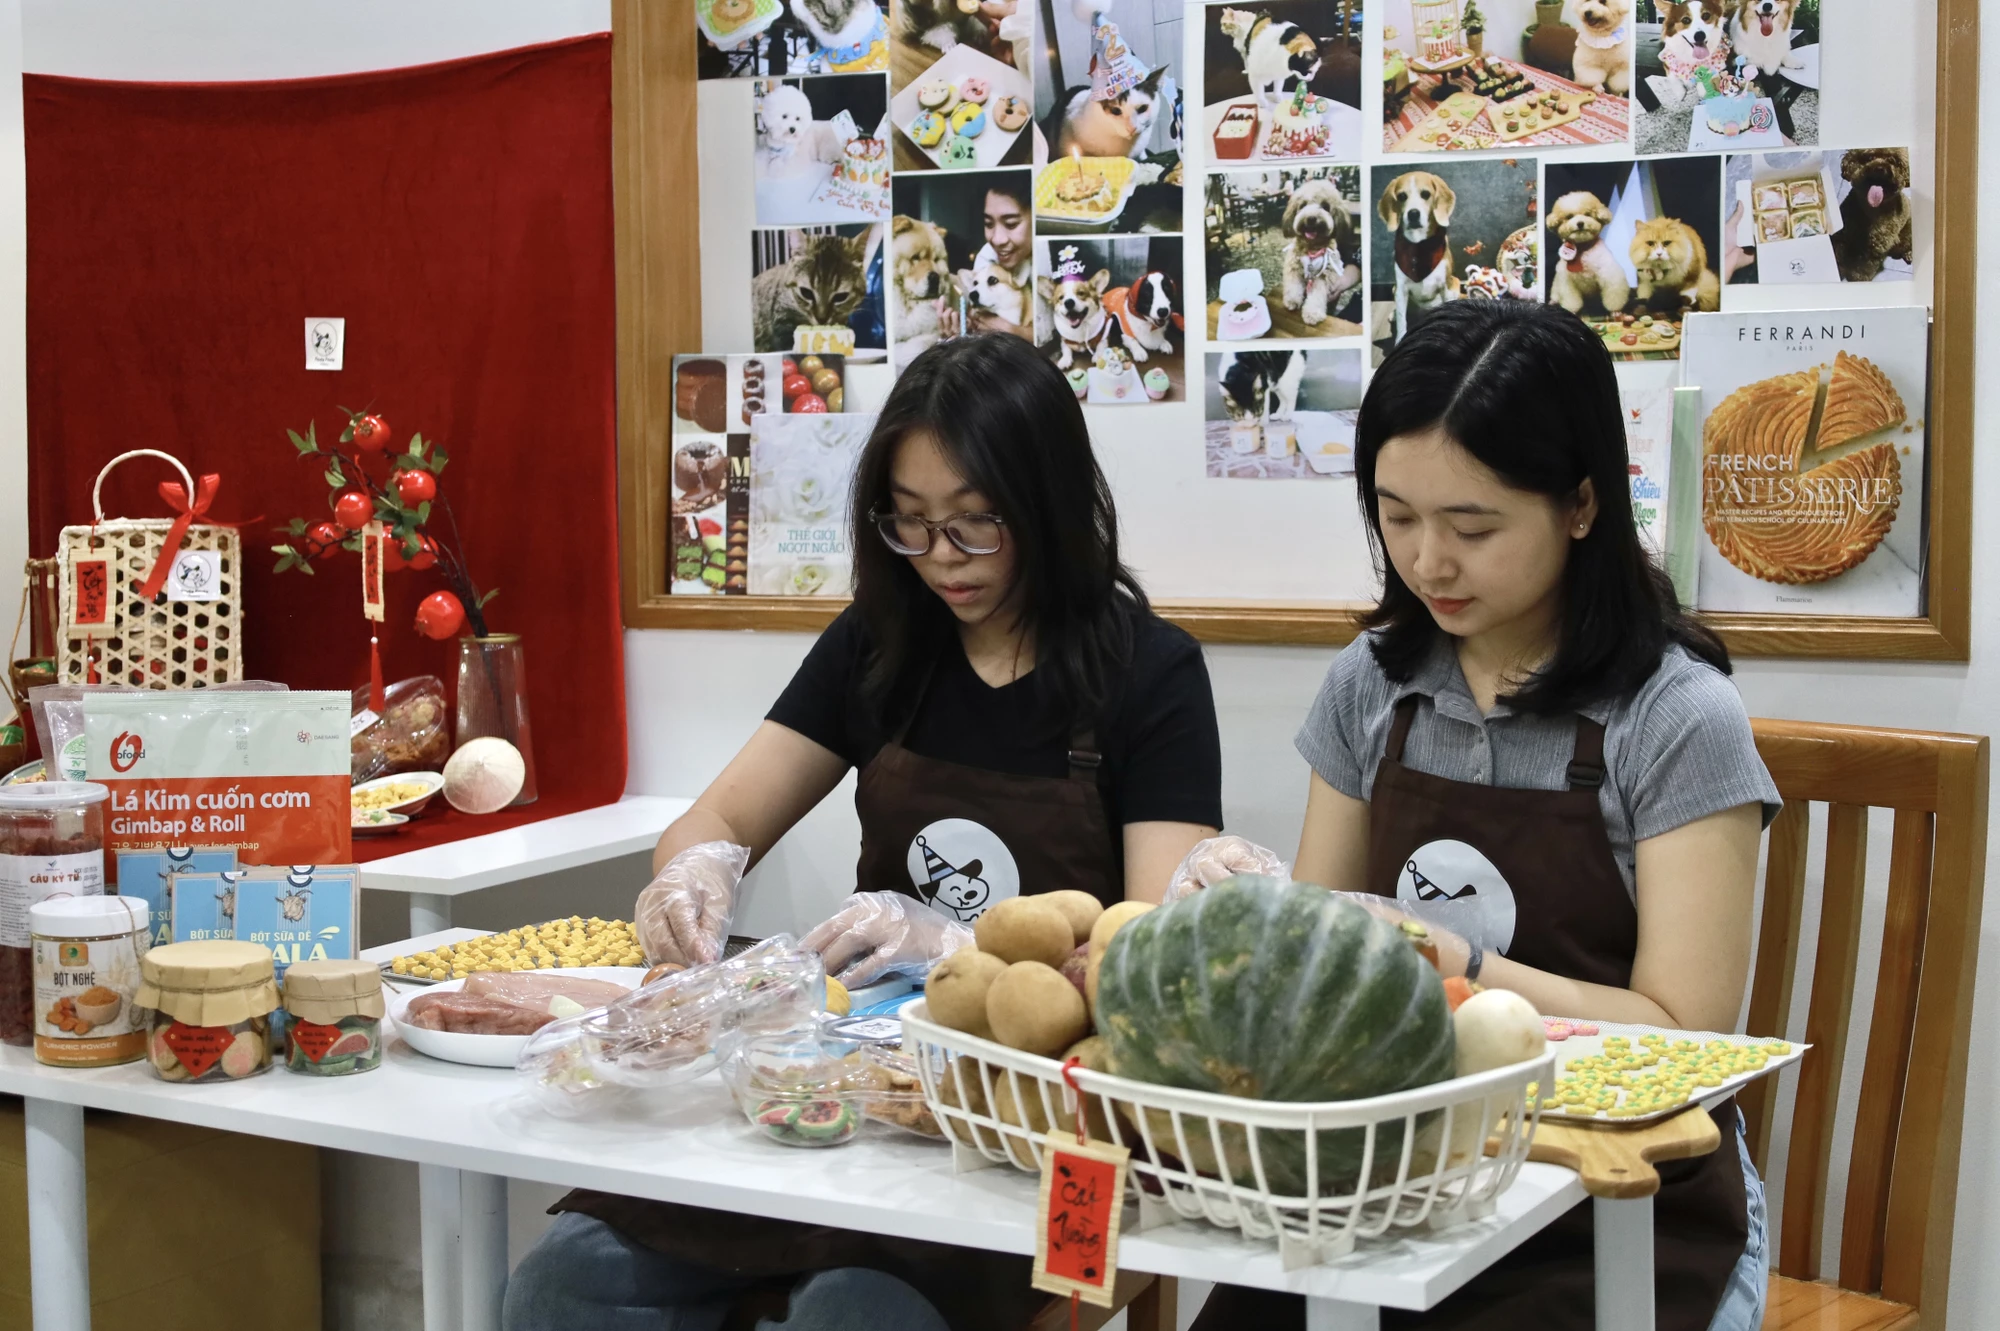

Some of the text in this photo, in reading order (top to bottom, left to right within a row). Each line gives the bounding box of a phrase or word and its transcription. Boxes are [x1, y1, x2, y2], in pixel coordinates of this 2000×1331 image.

[1738, 325, 1866, 341] FERRANDI
[1707, 454, 1793, 471] FRENCH
[1705, 474, 1892, 515] PÂTISSERIE
[111, 785, 311, 811] Lá Kim cuốn cơm
[110, 814, 246, 837] Gimbap & Roll
[250, 929, 312, 943] BỘT SỮA DÊ
[43, 1041, 118, 1051] TURMERIC POWDER
